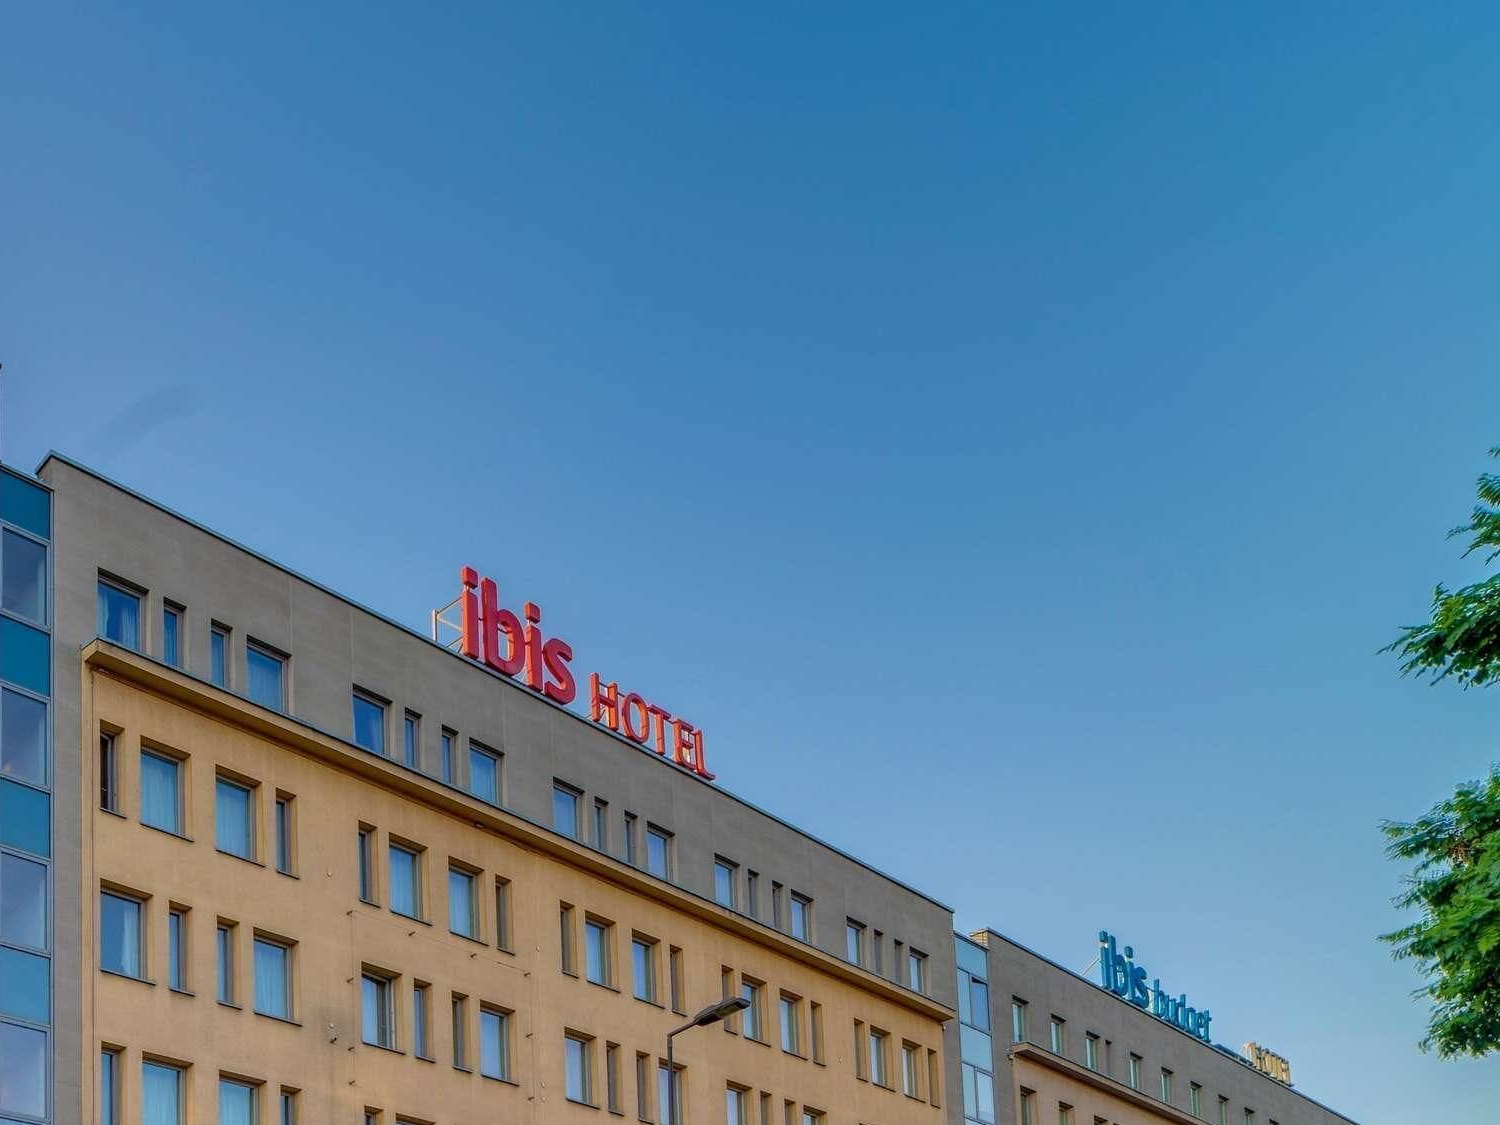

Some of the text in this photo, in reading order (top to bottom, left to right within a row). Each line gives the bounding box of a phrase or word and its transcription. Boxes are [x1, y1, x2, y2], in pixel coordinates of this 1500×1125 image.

[461, 565, 716, 781] ibis HOTEL
[1098, 930, 1212, 1042] ibis budget
